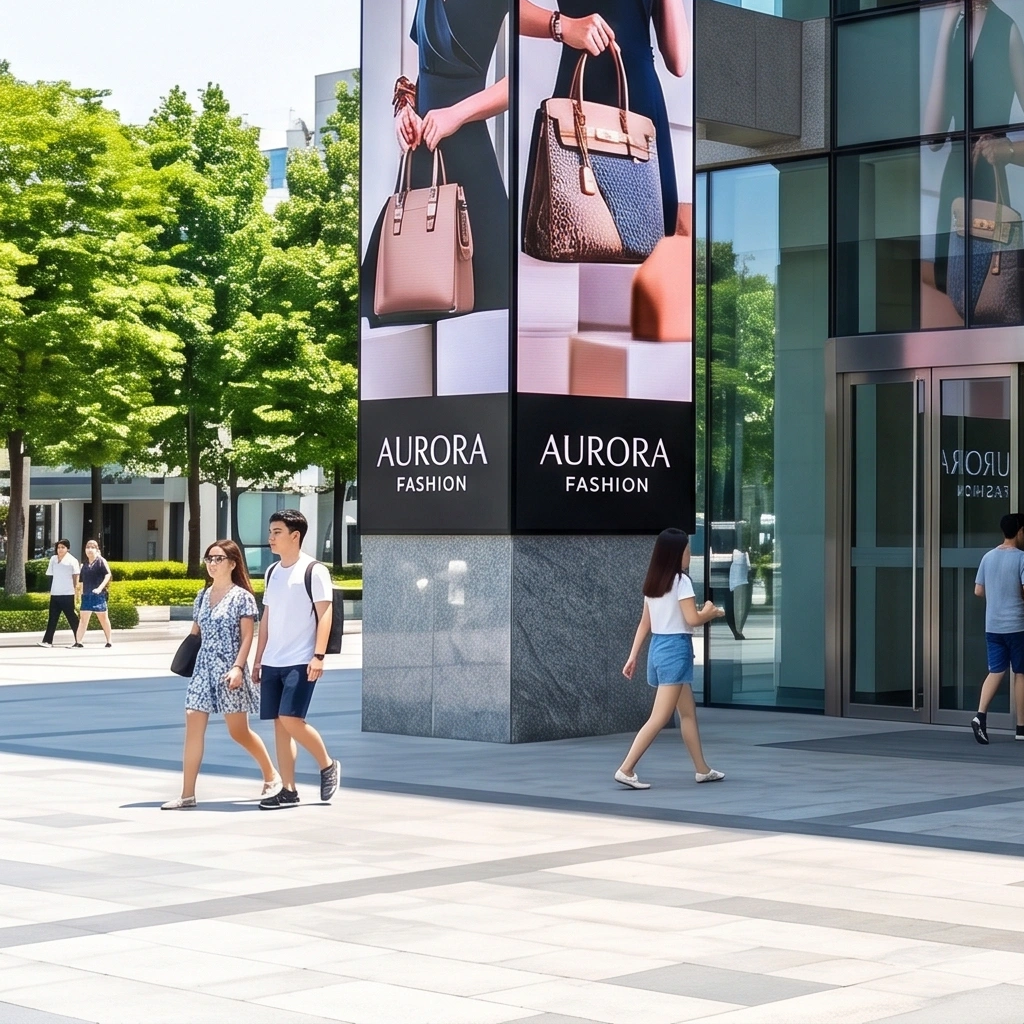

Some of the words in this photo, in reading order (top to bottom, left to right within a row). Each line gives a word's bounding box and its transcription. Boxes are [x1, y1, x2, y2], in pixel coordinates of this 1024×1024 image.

[376, 433, 488, 467] AURORA
[539, 433, 671, 468] AURORA
[396, 475, 467, 493] FASHION
[565, 476, 649, 493] FASHION
